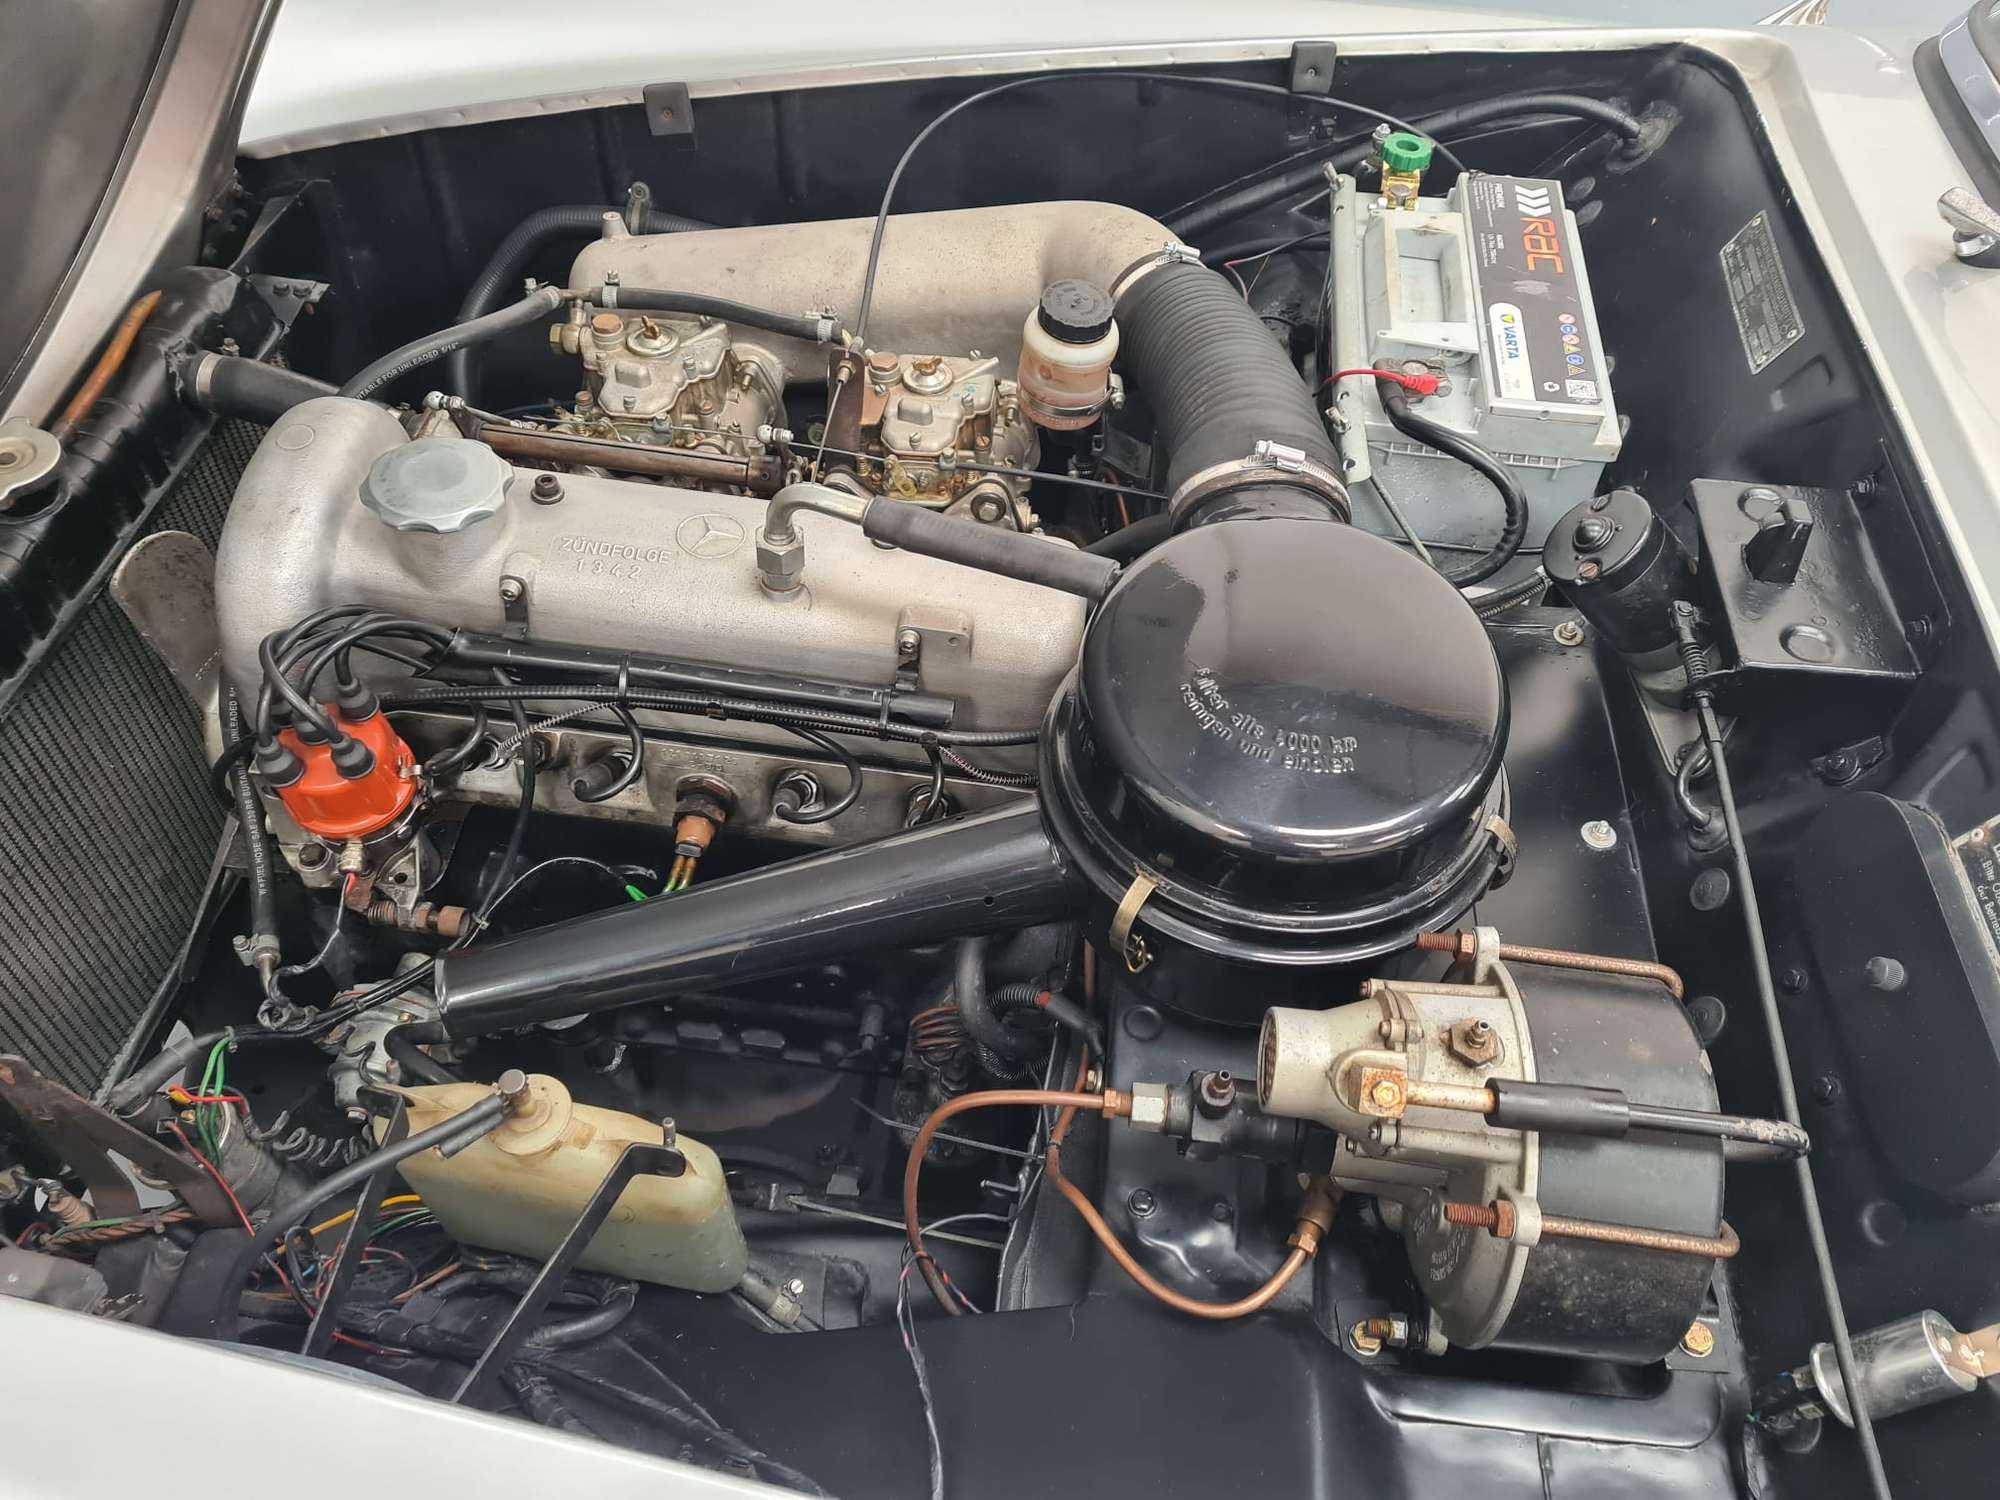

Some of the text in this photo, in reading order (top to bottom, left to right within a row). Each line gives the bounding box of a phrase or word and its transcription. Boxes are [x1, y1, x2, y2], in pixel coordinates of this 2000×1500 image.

[1503, 325, 1520, 359] VARTA
[398, 349, 439, 372] UNLEADED
[560, 535, 672, 564] ZÜNDFOLGE
[229, 700, 240, 742] UNLEADED
[1180, 683, 1232, 741] reinigen
[1239, 738, 1275, 763] und
[1232, 712, 1264, 739] alle
[1329, 736, 1358, 754] km
[252, 842, 264, 864] HOSE
